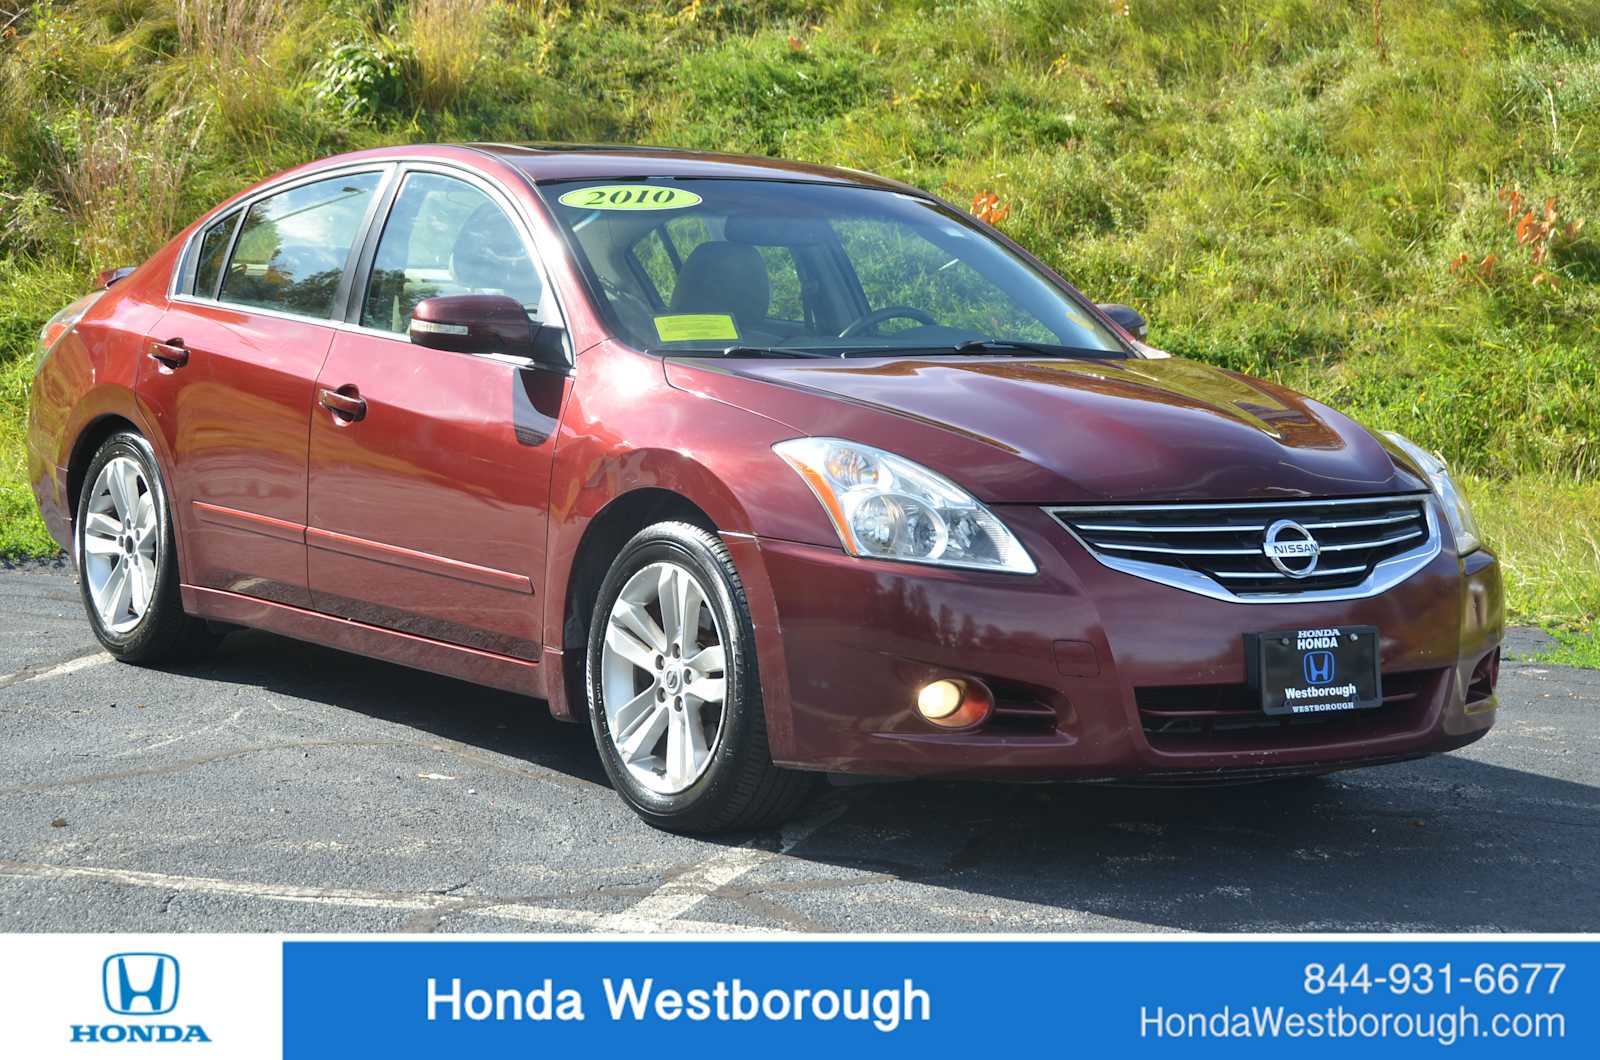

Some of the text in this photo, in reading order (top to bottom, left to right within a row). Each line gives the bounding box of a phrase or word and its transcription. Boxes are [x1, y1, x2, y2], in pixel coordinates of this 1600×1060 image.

[585, 190, 676, 205] 2010
[1273, 543, 1318, 555] NISSAN
[1297, 628, 1341, 639] HONDA
[1297, 637, 1339, 650] HONDA
[1284, 683, 1357, 699] Westborough
[1292, 702, 1354, 713] WESTBOROUGH
